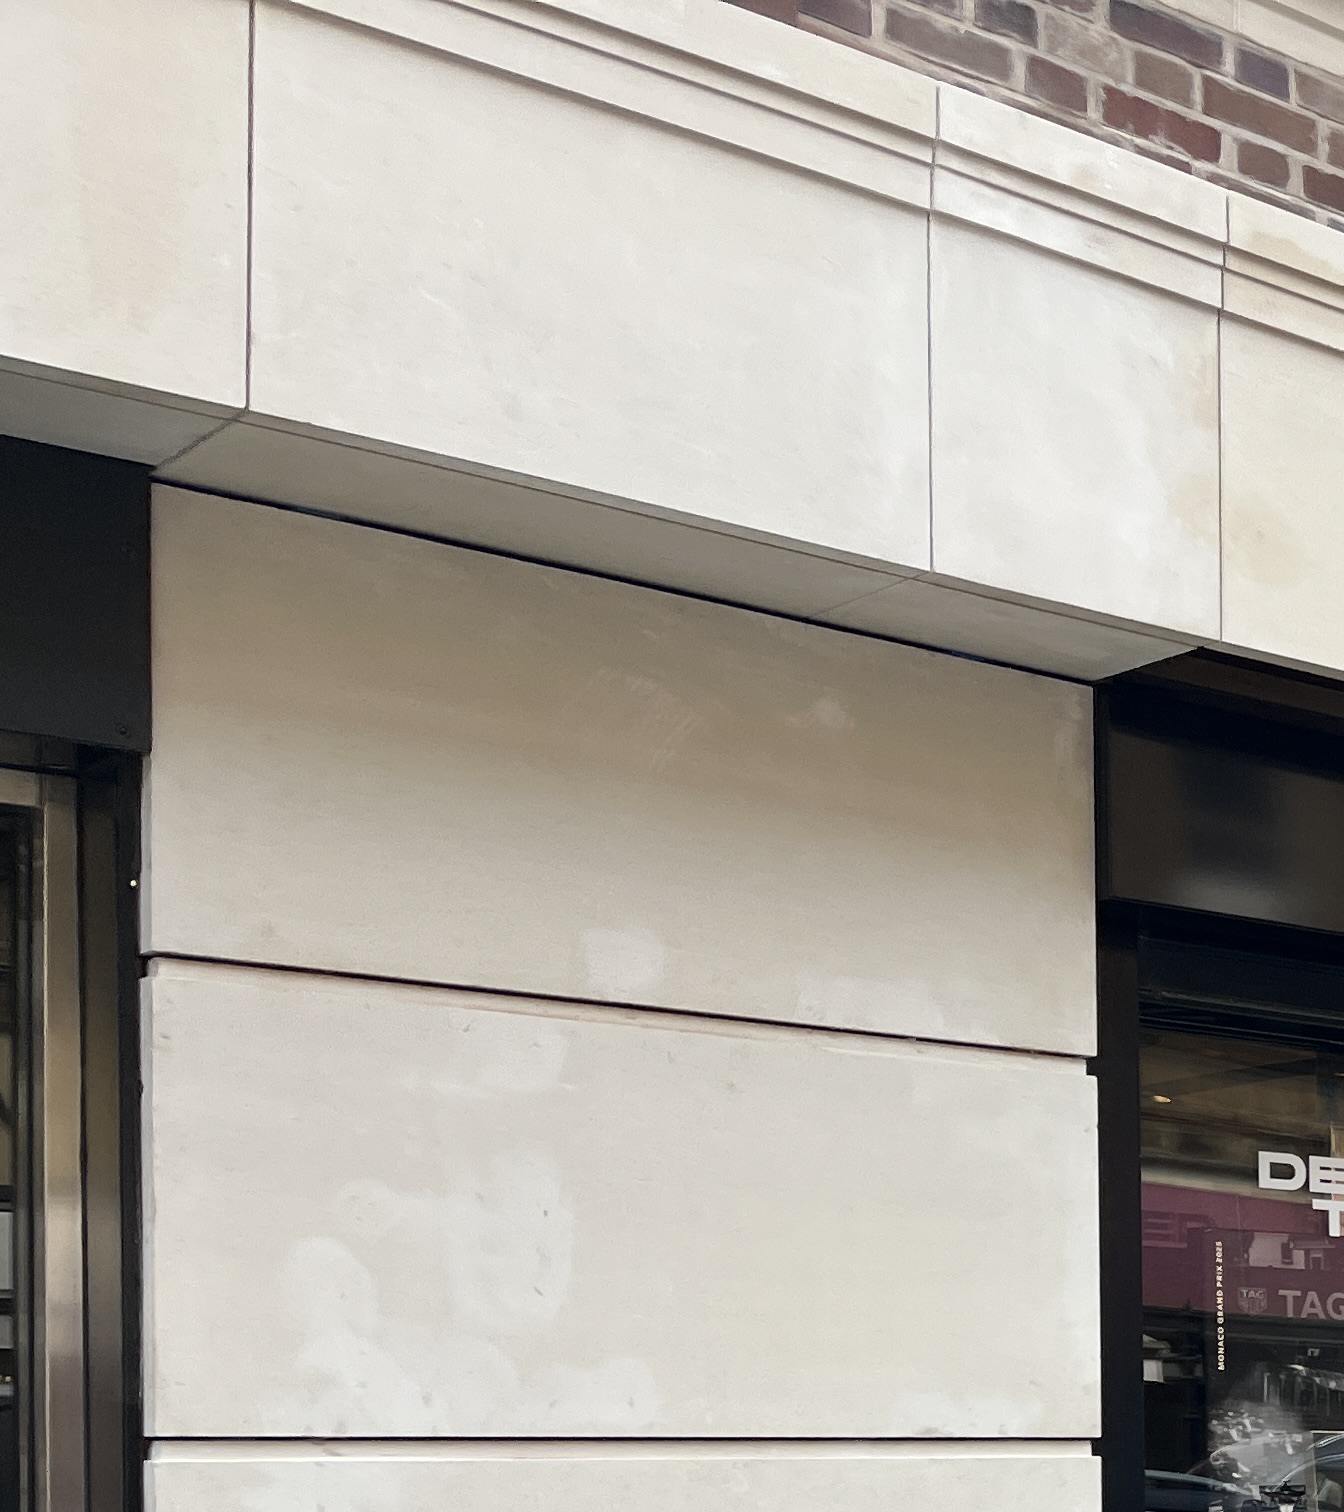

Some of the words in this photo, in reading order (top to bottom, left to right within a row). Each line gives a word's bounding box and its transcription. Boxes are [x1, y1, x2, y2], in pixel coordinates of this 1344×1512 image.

[1215, 1265, 1223, 1288] PRIX
[1216, 1289, 1225, 1324] GRAND
[1217, 1326, 1225, 1371] MONACO
